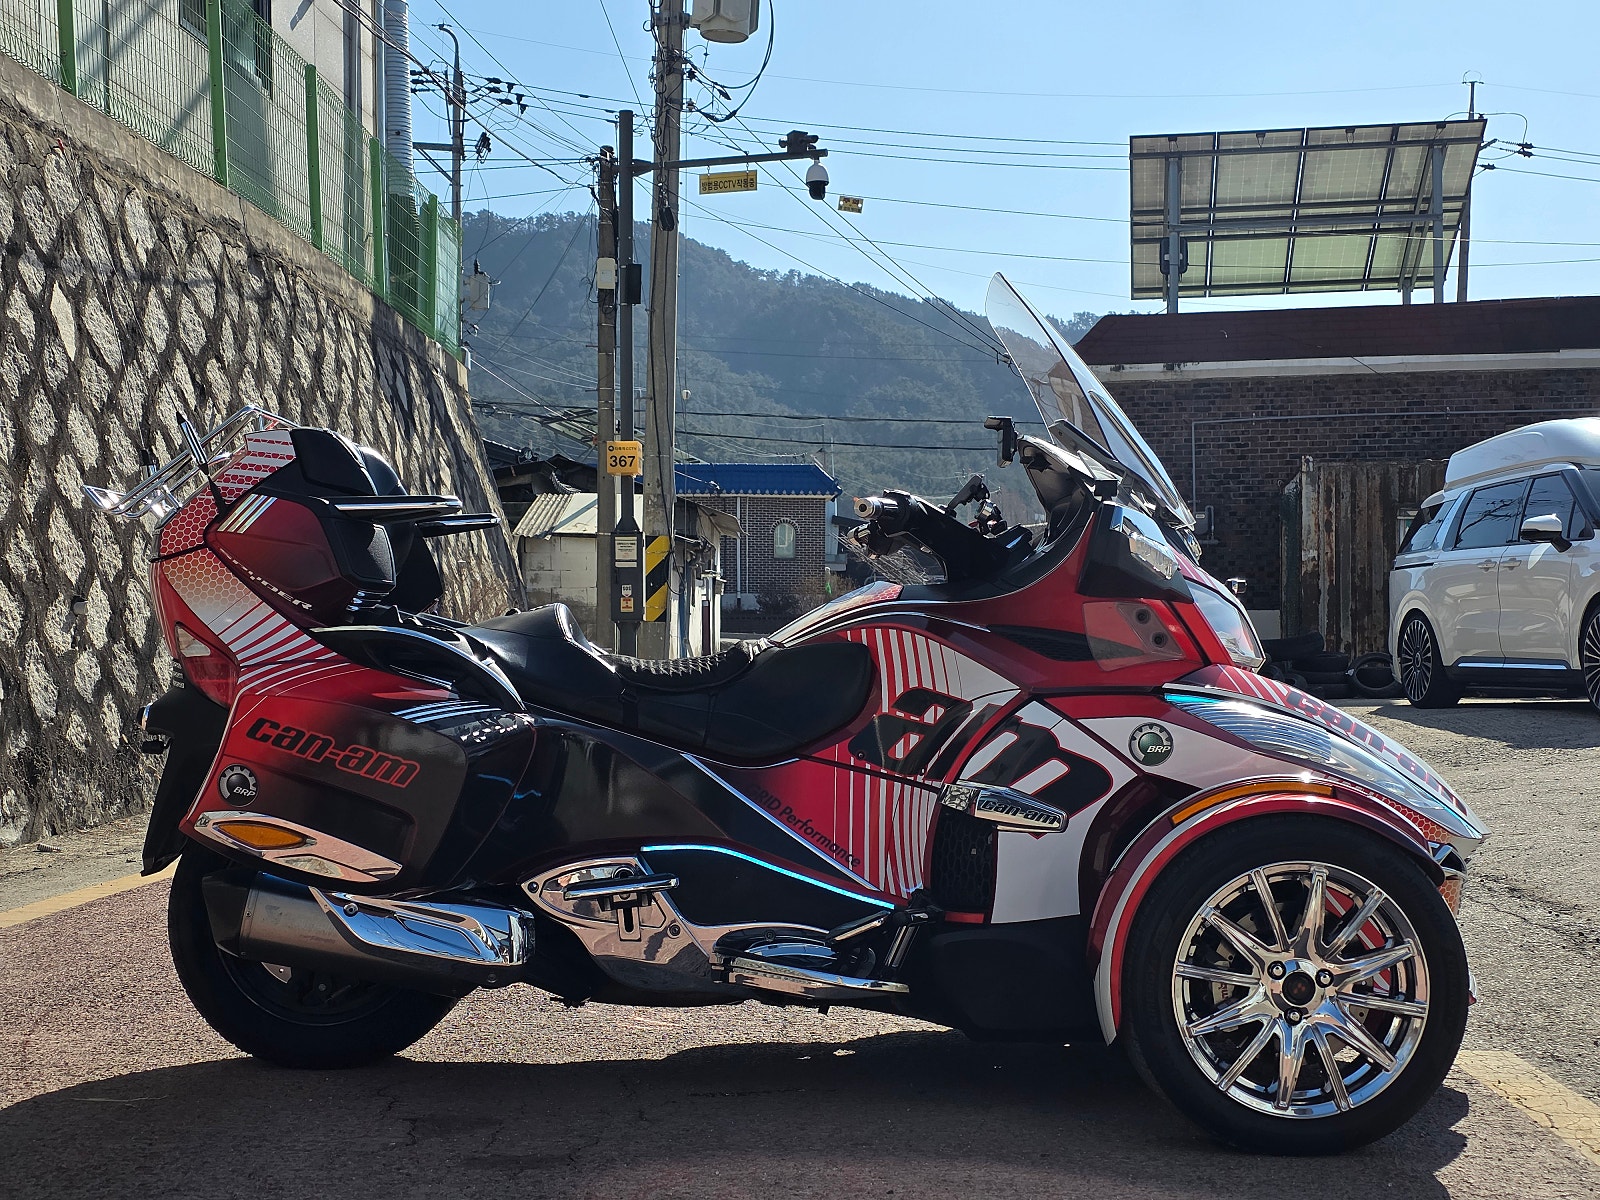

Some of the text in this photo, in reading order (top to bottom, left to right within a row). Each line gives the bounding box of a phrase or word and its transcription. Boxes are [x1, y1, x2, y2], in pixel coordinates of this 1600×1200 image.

[609, 455, 636, 468] 367
[246, 717, 421, 788] can-am
[1147, 745, 1171, 753] BRP
[233, 786, 256, 797] BRP
[980, 799, 1061, 825] can-am
[779, 805, 861, 867] Performance
